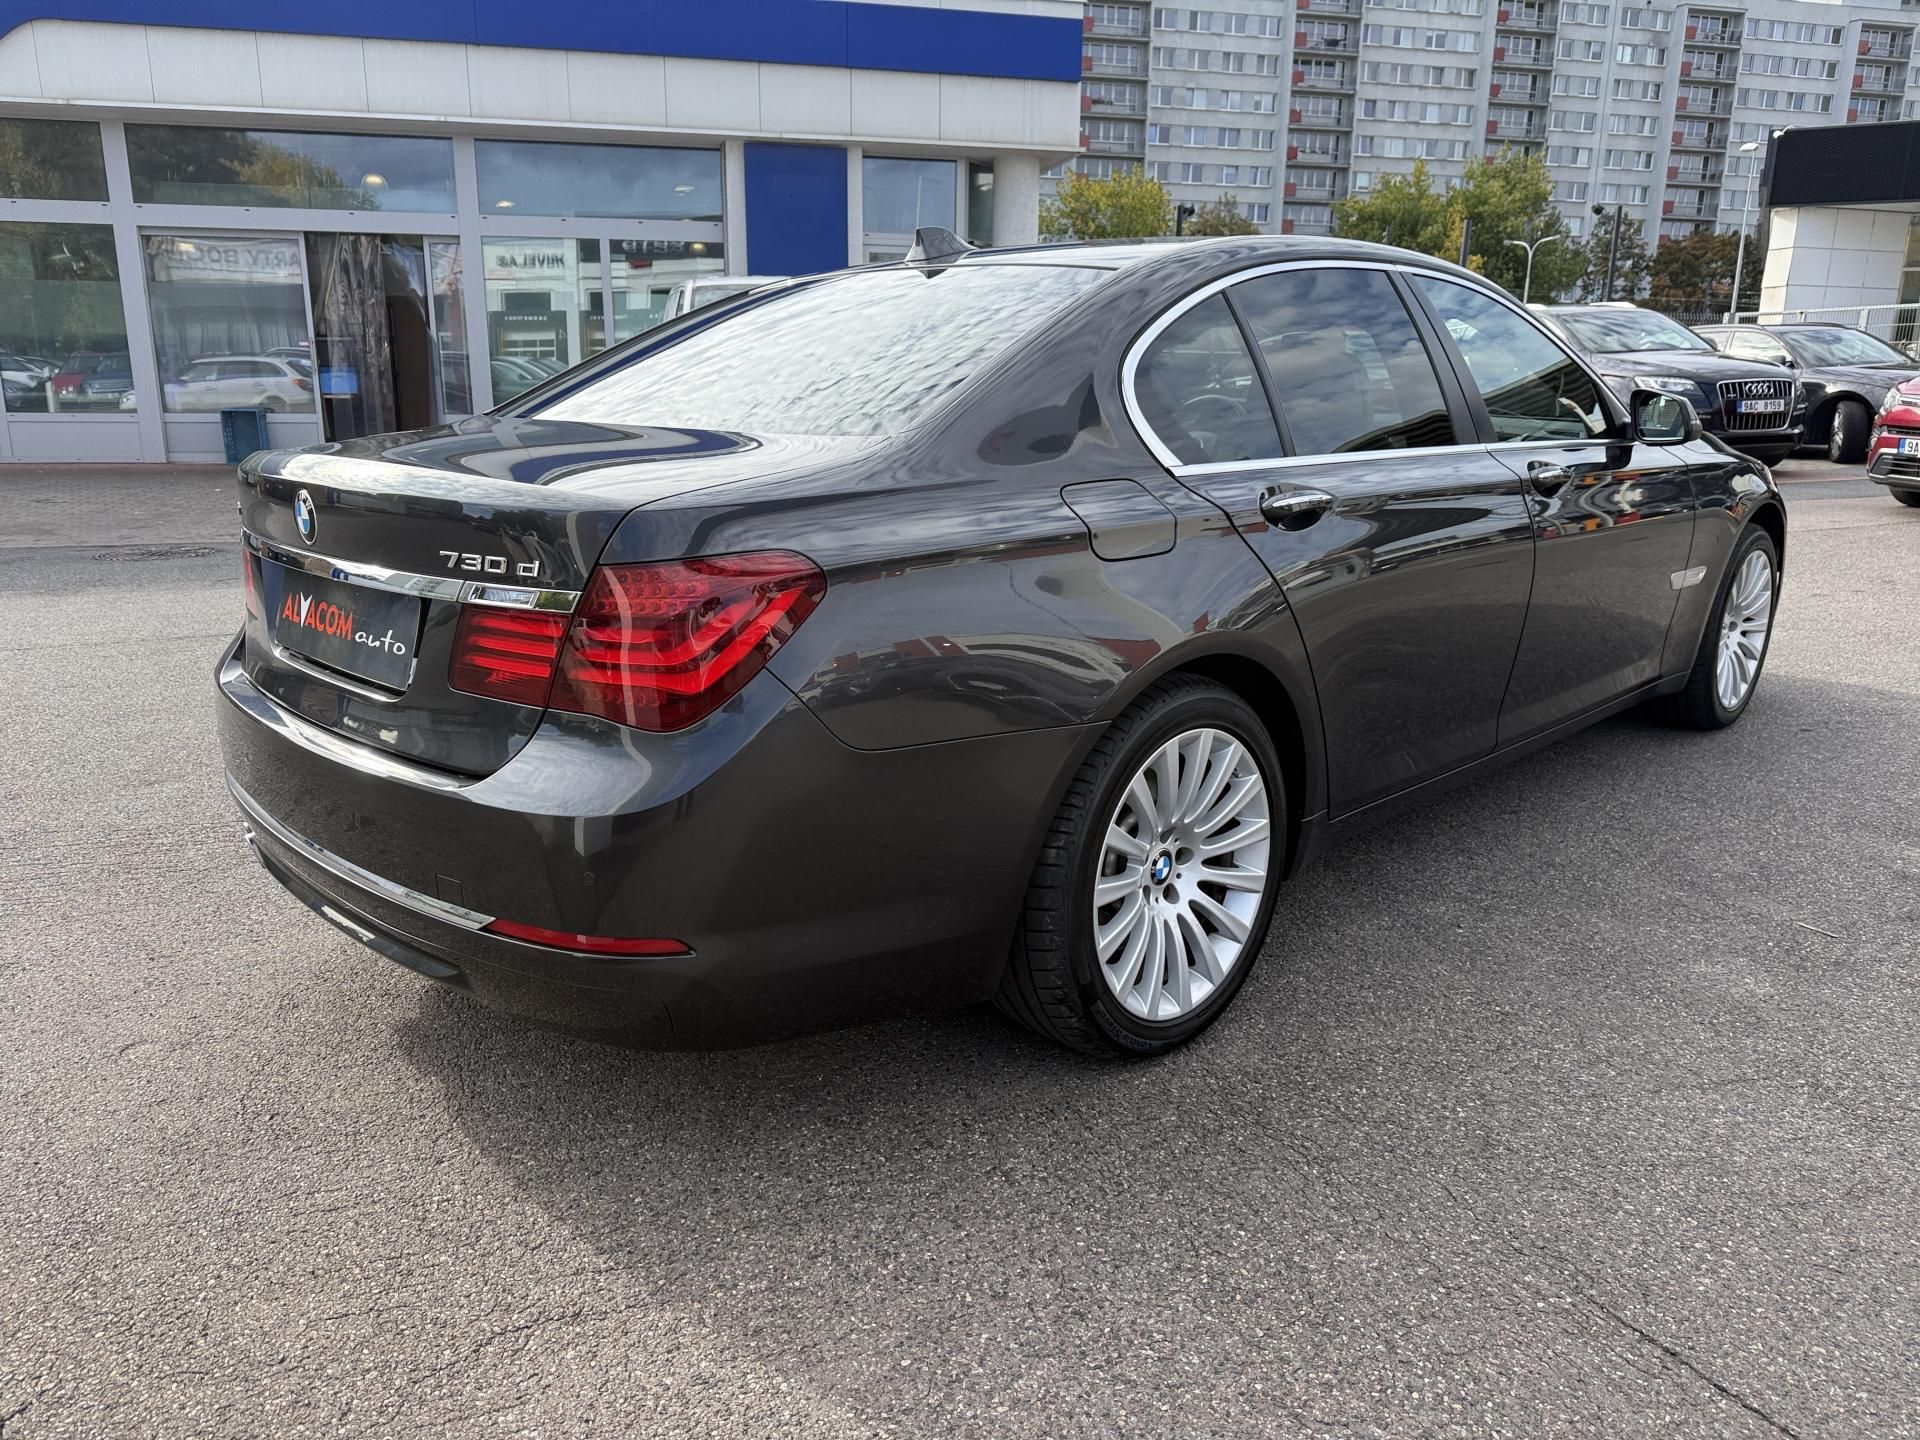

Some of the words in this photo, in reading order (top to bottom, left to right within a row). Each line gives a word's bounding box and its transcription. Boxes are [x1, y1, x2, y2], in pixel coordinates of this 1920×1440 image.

[1744, 402, 1759, 411] 9AC
[1763, 400, 1782, 410] 8159
[439, 550, 508, 574] 730
[516, 560, 540, 577] d
[354, 629, 406, 655] auto
